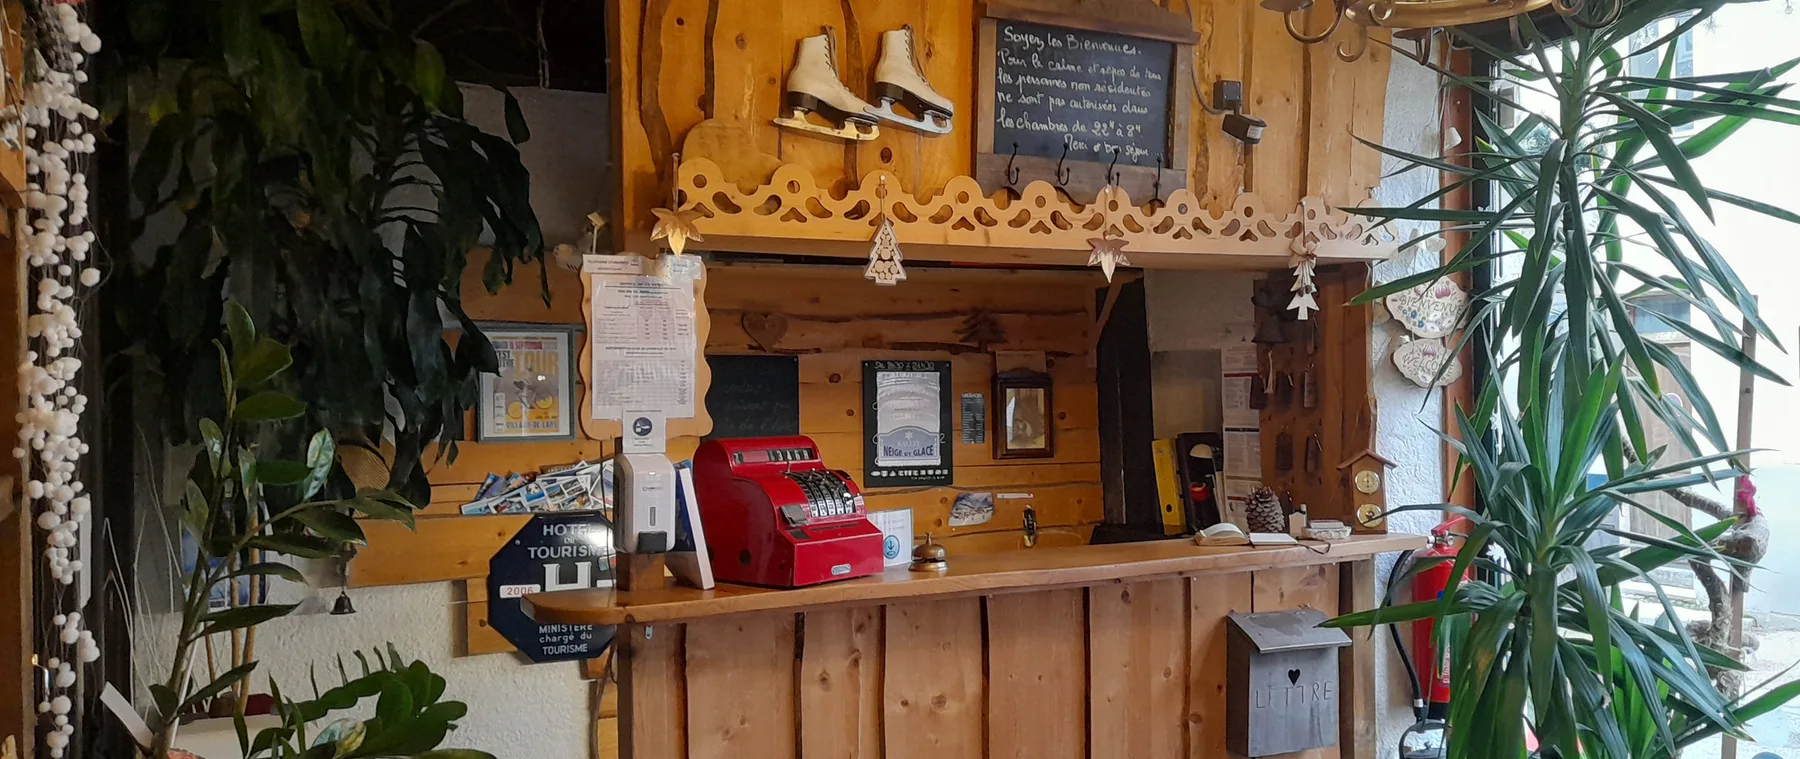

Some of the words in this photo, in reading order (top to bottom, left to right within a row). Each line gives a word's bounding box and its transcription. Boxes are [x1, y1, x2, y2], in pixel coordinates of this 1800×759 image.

[1004, 26, 1044, 51] Soyez
[1047, 32, 1062, 48] les
[997, 47, 1026, 66] Pour
[1031, 52, 1043, 69] le
[1048, 58, 1082, 73] calme
[1099, 66, 1126, 83] repos
[997, 67, 1013, 84] les
[1015, 74, 1067, 94] personnes
[1071, 80, 1092, 91] non
[997, 90, 1013, 104] ne
[1017, 91, 1045, 105] sont
[1048, 95, 1066, 112] pas
[1122, 101, 1149, 114] dans
[1072, 120, 1087, 133] de
[512, 351, 559, 379] TOUR
[883, 445, 903, 456] NEIGE
[912, 445, 934, 456] GLACE
[506, 586, 534, 596] 2006
[539, 631, 575, 644] chargé
[579, 631, 592, 640] du
[542, 643, 588, 656] TOURISME
